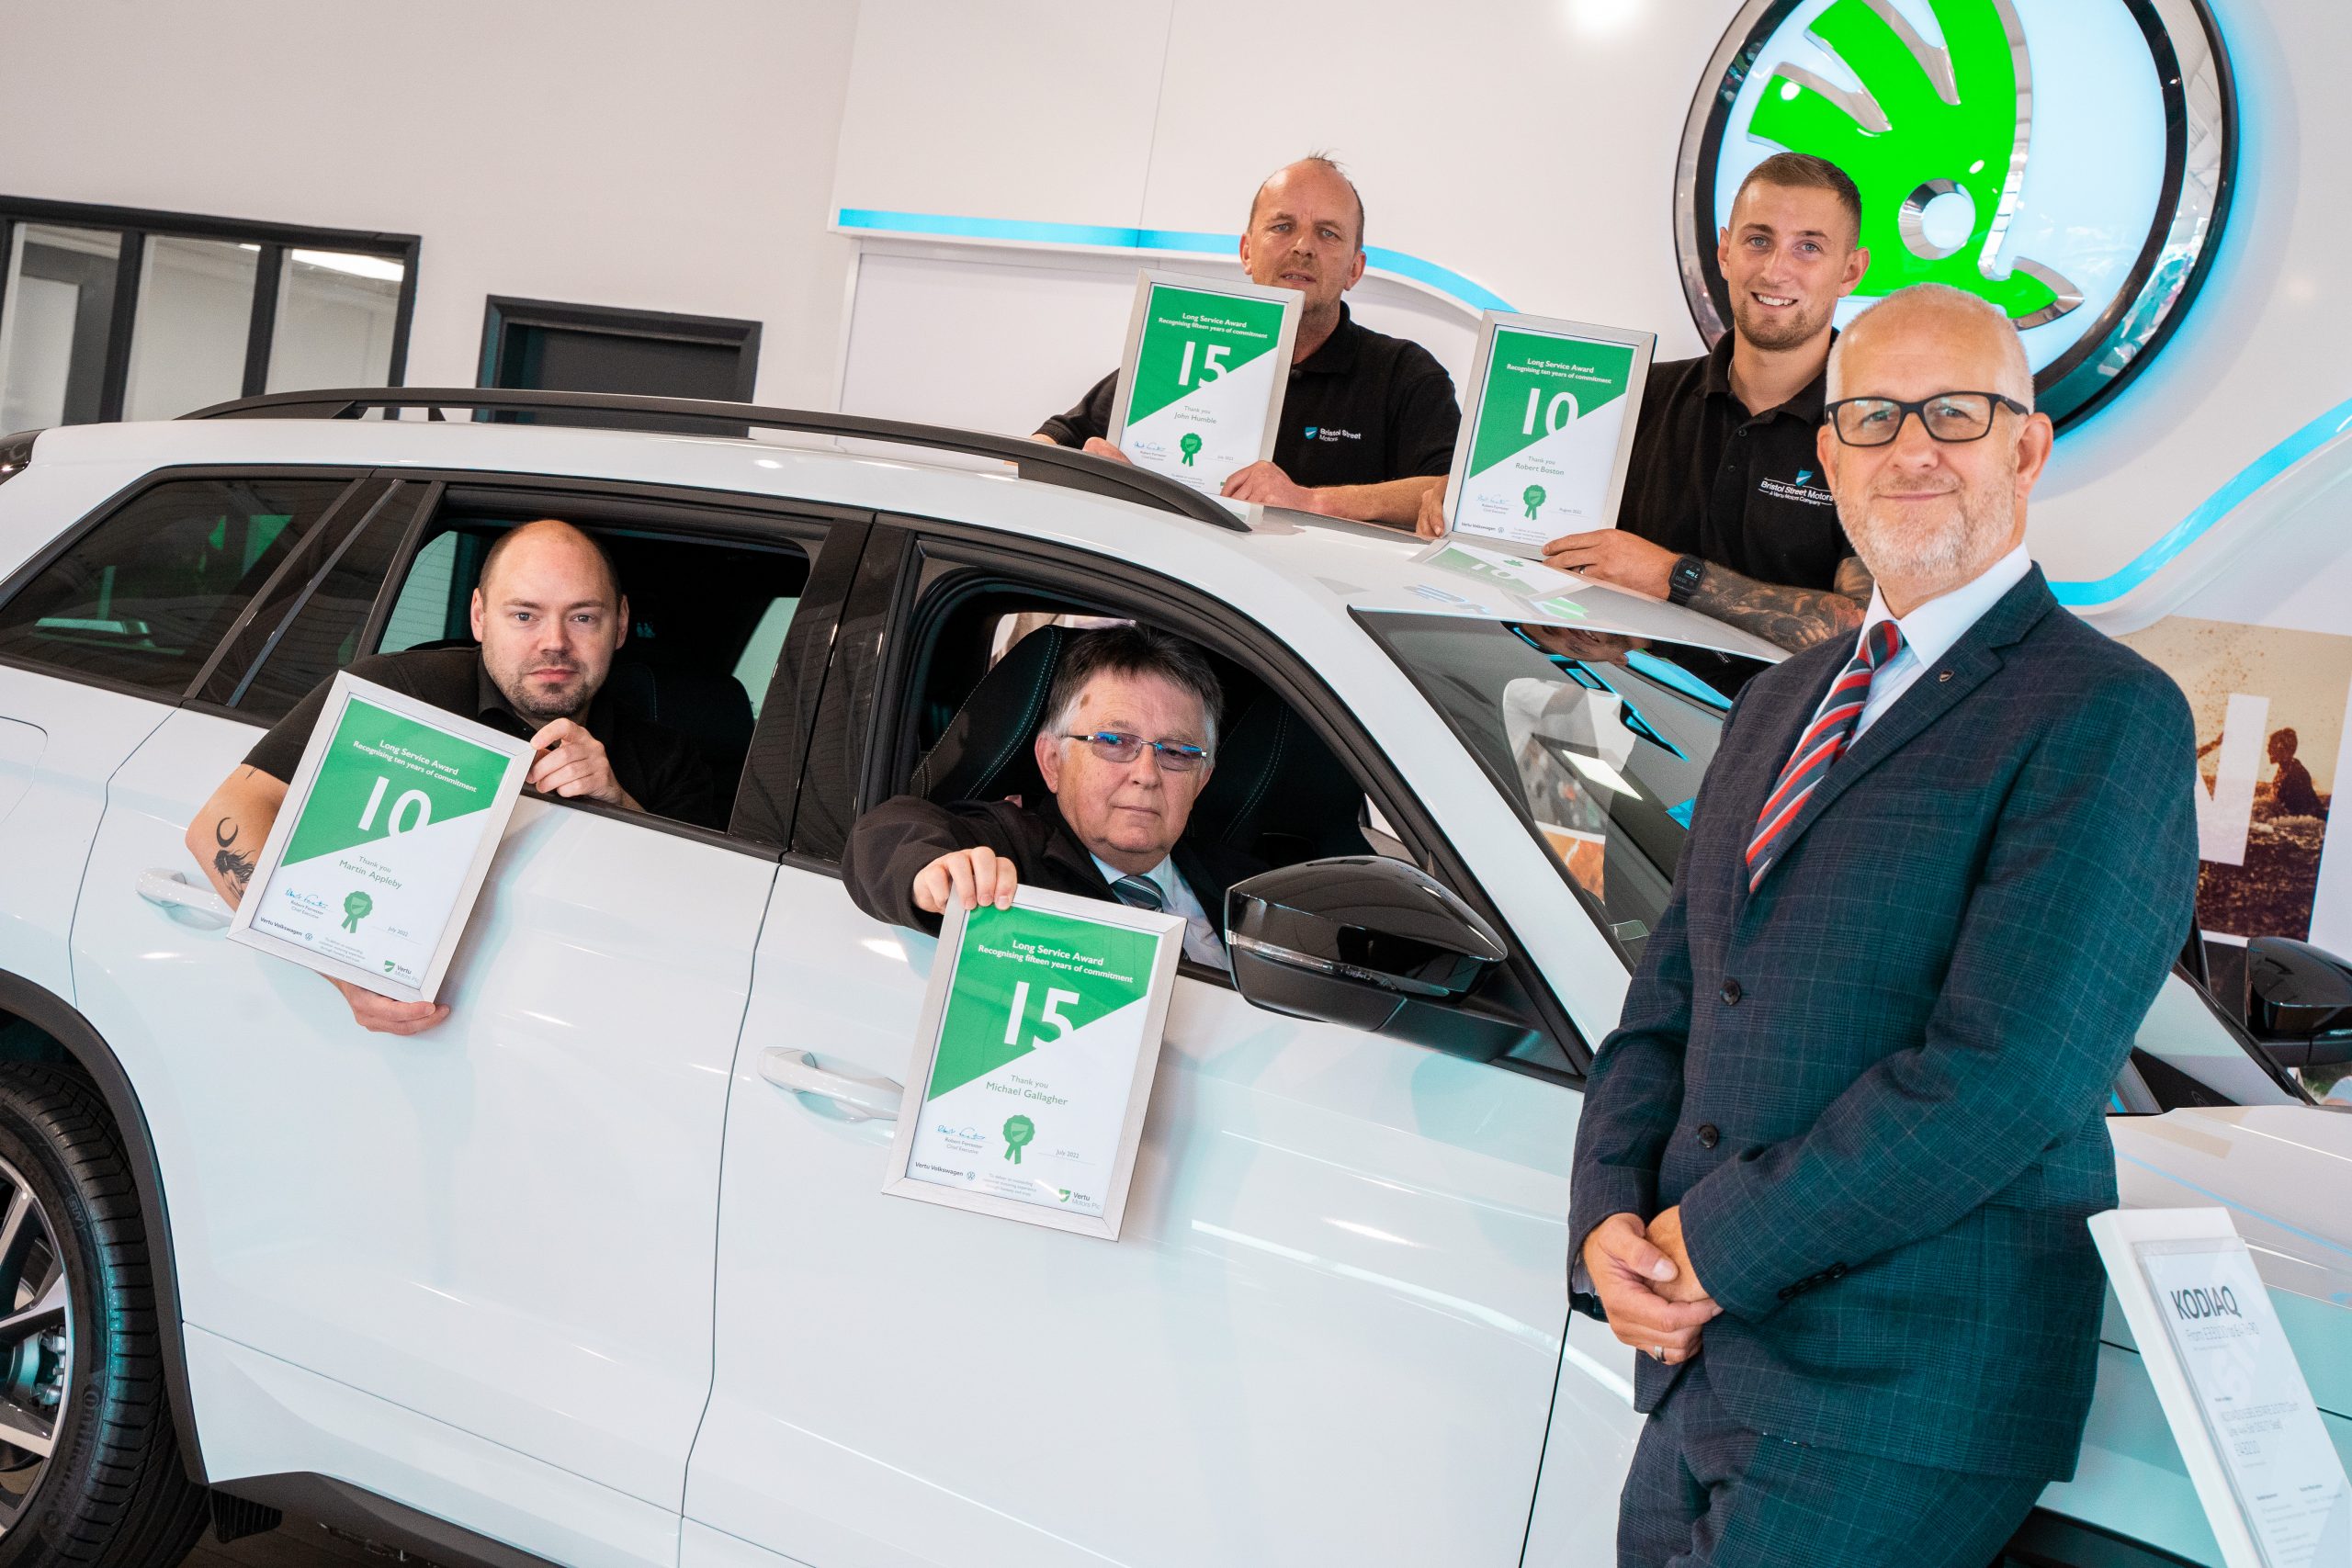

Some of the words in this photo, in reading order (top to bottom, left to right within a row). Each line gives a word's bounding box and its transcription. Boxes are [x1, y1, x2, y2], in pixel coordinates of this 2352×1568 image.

[1158, 317, 1192, 329] Recognising
[1191, 321, 1210, 330] fifteen
[1232, 329, 1268, 339] commitment
[1182, 312, 1200, 322] Long
[1199, 315, 1224, 325] Service
[1224, 319, 1248, 328] Award
[1178, 341, 1230, 387] 15
[1506, 363, 1541, 375] Recognising
[1551, 370, 1567, 378] years
[1575, 374, 1612, 384] commitment
[1526, 357, 1545, 368] Long
[1544, 360, 1570, 370] Service
[1570, 364, 1595, 374] Award
[1173, 412, 1190, 421] John
[1191, 414, 1217, 424] Humble
[1522, 388, 1578, 435] 10
[1320, 428, 1340, 436] Bristol
[1342, 430, 1362, 439] Street
[1760, 480, 1784, 492] Bristol
[1784, 486, 1807, 496] Street
[1807, 490, 1833, 502] Motors
[1799, 496, 1821, 506] Company
[352, 739, 394, 762] Recognising
[393, 756, 406, 766] ten
[405, 761, 425, 773] years
[424, 768, 435, 776] of
[433, 772, 478, 793] commitment
[379, 739, 401, 755] Long
[401, 747, 431, 765] Service
[430, 759, 459, 776] Award
[358, 776, 432, 838] 10
[338, 859, 368, 876] Martin
[368, 870, 403, 891] Appleby
[358, 855, 376, 867] Thank
[374, 863, 392, 874] you
[259, 916, 275, 926] Vertu
[273, 921, 303, 937] Volkswagen
[1011, 940, 1036, 954] Long
[1036, 944, 1071, 960] Service
[1071, 952, 1105, 966] Award
[396, 964, 413, 975] Vertu
[977, 944, 1024, 963] Recognising
[1024, 953, 1050, 966] fifteen
[1050, 960, 1073, 972] years
[1072, 964, 1083, 973] of
[1082, 967, 1134, 984] commitment
[1004, 981, 1080, 1049] 15
[1011, 1074, 1034, 1086] Thank
[1034, 1081, 1049, 1089] you
[985, 1080, 1023, 1096] Michael
[1023, 1089, 1069, 1107] Gallagher
[1055, 1148, 1067, 1157] July
[1066, 1150, 1080, 1159] 2022
[914, 1161, 931, 1170] Vertu
[930, 1164, 964, 1178] Volkswagen
[1072, 1191, 1091, 1201] Vertu
[2170, 1286, 2242, 1320] KODIAQ
